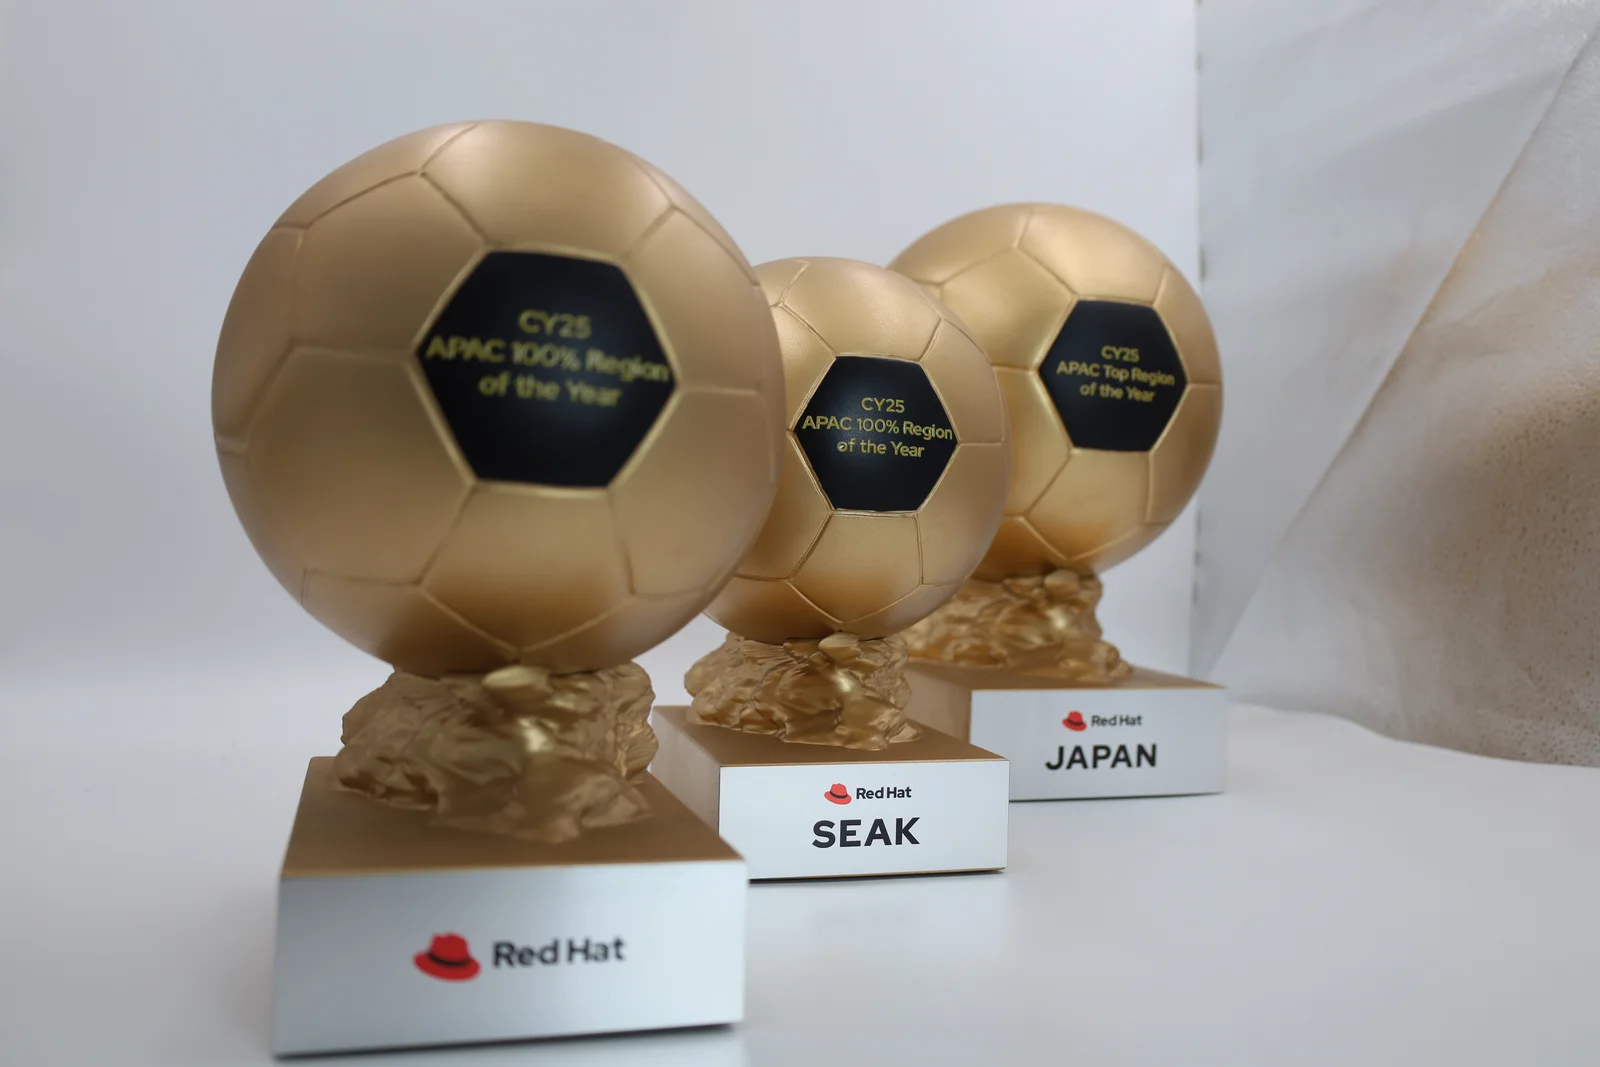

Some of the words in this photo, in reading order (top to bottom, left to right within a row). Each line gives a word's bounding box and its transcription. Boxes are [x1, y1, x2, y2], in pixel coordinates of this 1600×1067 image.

[518, 310, 592, 339] CY25
[426, 336, 505, 362] APAC
[512, 341, 582, 372] 100%
[586, 349, 669, 382] Region
[1101, 345, 1140, 362] CY25
[1056, 361, 1100, 377] APAC
[1103, 364, 1130, 382] Top
[1131, 367, 1175, 386] Region
[478, 371, 510, 396] of
[515, 374, 560, 399] the
[565, 380, 622, 407] Year
[1080, 382, 1097, 396] of
[1099, 384, 1123, 399] the
[1126, 386, 1155, 402] Year
[861, 397, 905, 413] CY25
[802, 415, 852, 431] APAC
[856, 418, 900, 434] 100%
[903, 421, 953, 441] Region
[837, 438, 856, 452] of
[860, 440, 887, 454] the
[890, 441, 925, 458] Year
[1091, 714, 1117, 726] Red
[1119, 714, 1142, 726] Hat
[1045, 743, 1157, 770] JAPAN
[856, 787, 884, 799] Red
[886, 786, 912, 799] Hat
[812, 817, 920, 848] SEAK
[492, 938, 561, 969] Red
[566, 937, 626, 965] Hat
